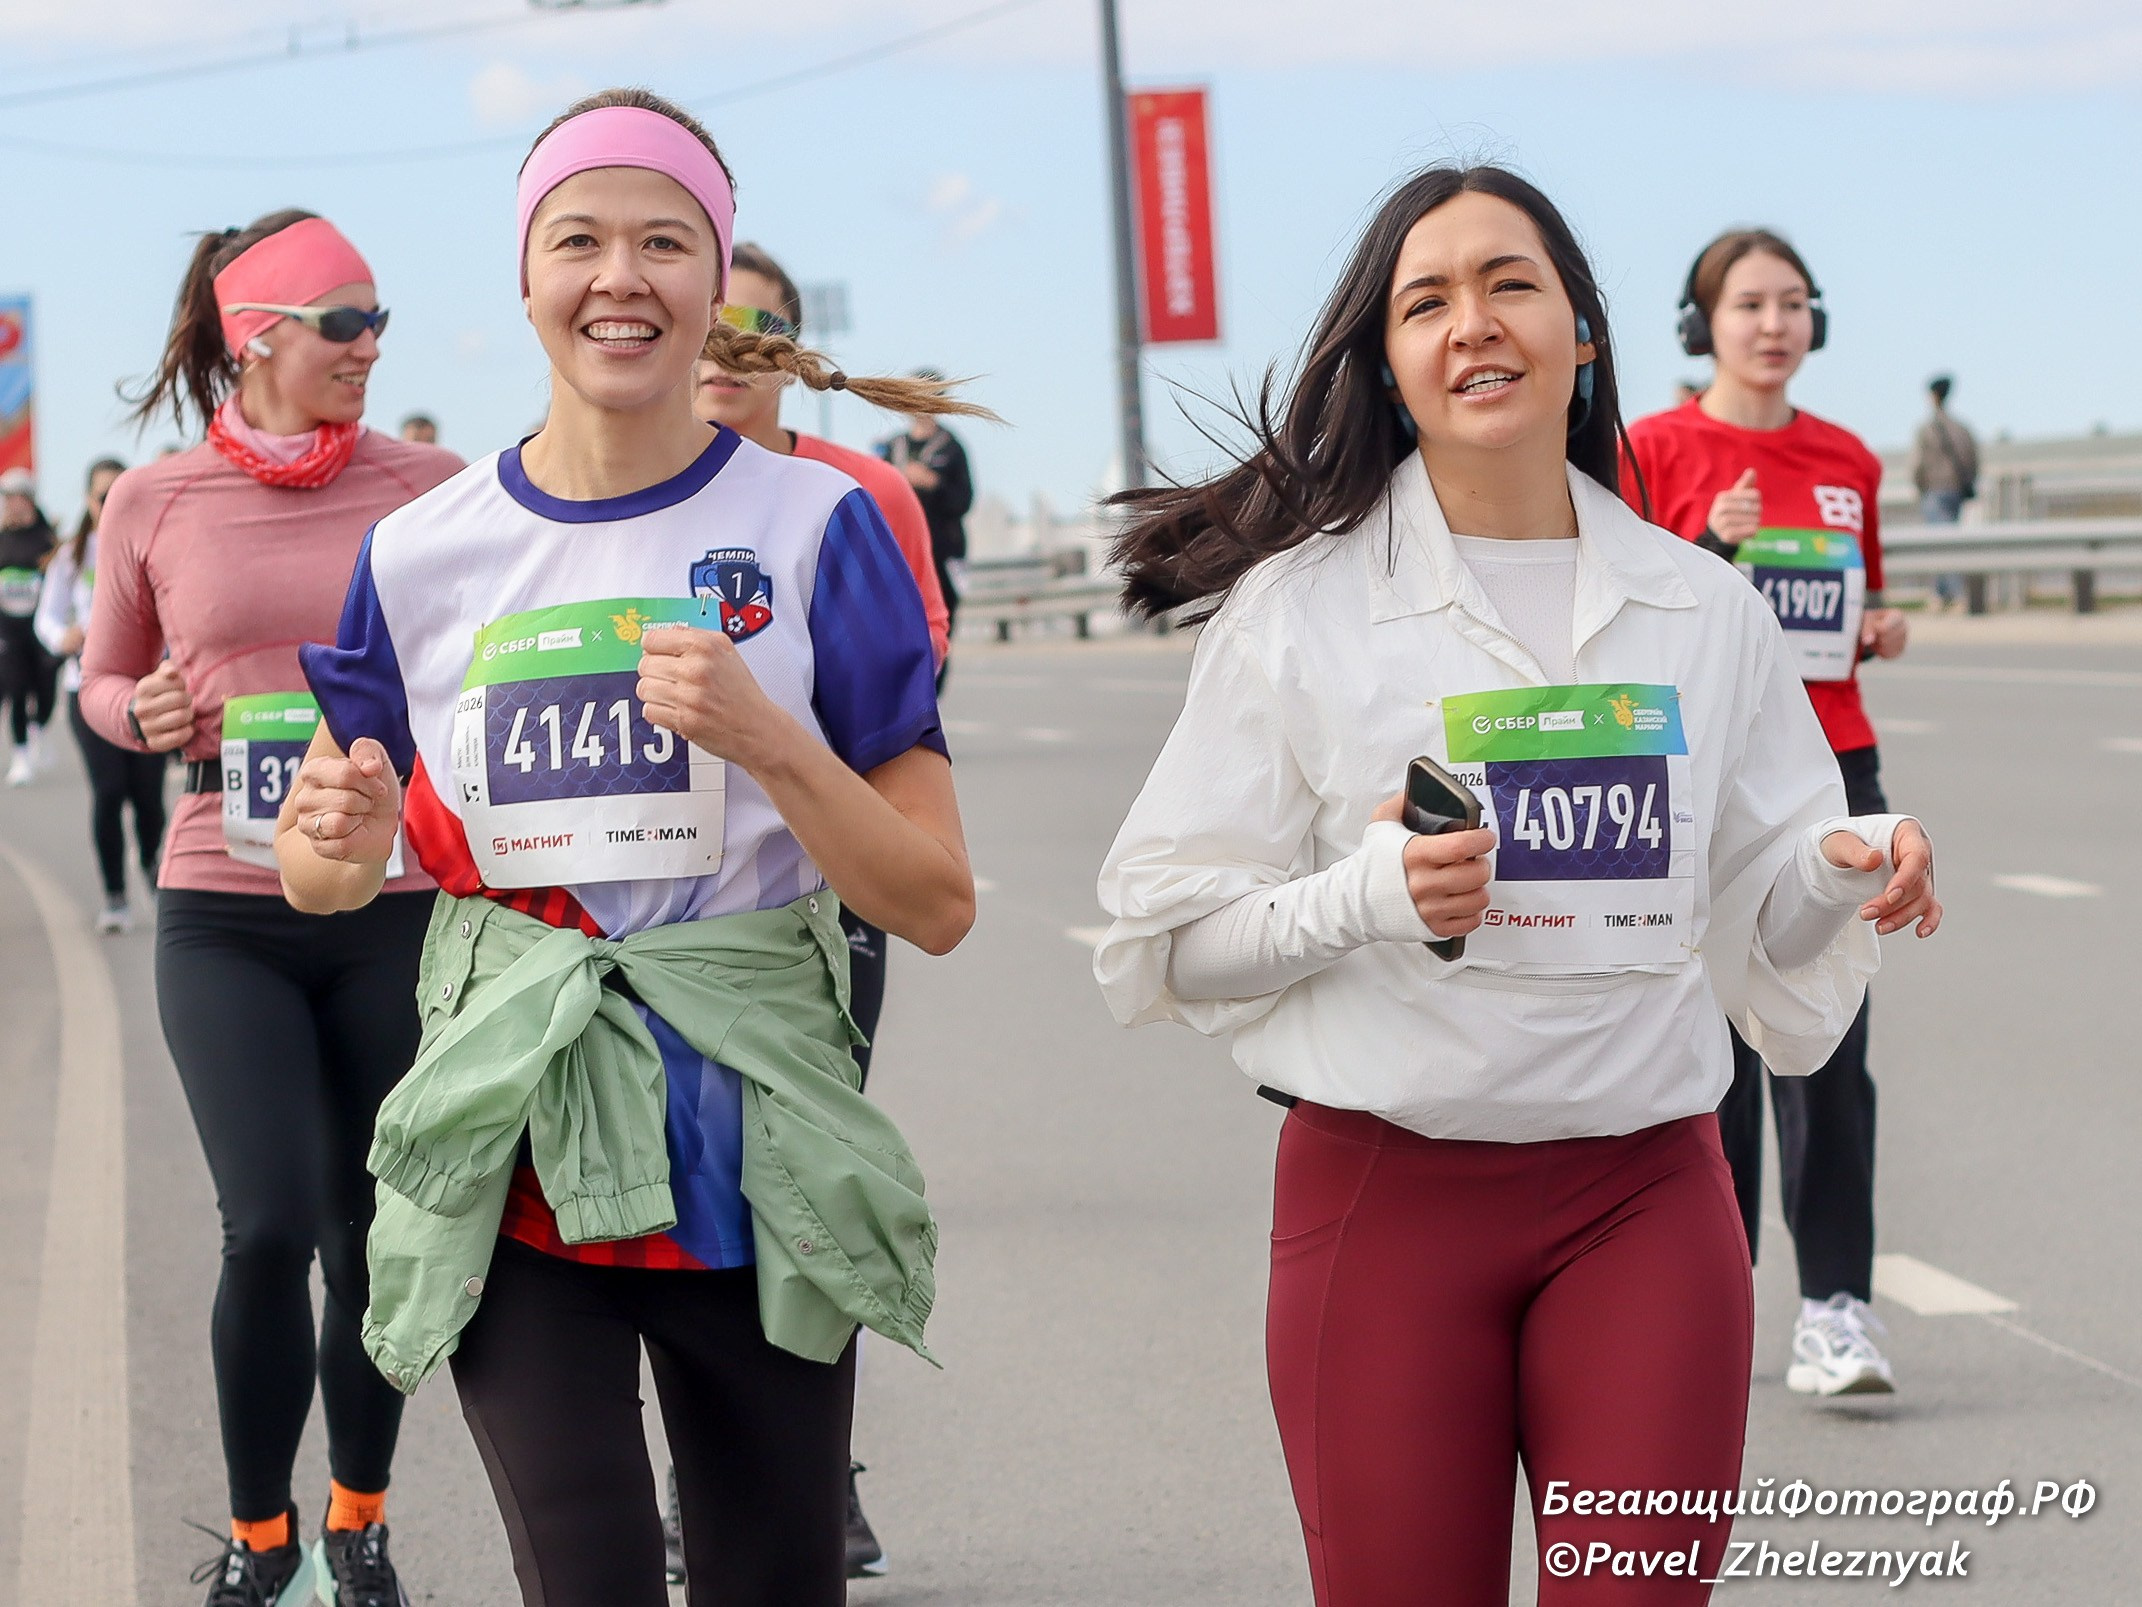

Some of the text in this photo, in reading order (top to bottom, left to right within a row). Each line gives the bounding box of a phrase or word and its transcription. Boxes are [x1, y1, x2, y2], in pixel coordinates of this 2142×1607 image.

[708, 550, 754, 561] ЧЕМПИ
[731, 572, 743, 599] 1
[499, 634, 574, 654] СБЕР Прайм
[457, 696, 484, 713] 2026
[1495, 716, 1576, 730] СБЕР Прайм
[503, 699, 674, 774] 41413
[1513, 783, 1663, 851] 40794
[511, 833, 574, 852] МАГНИТ
[1508, 915, 1576, 928] МАГНИТ
